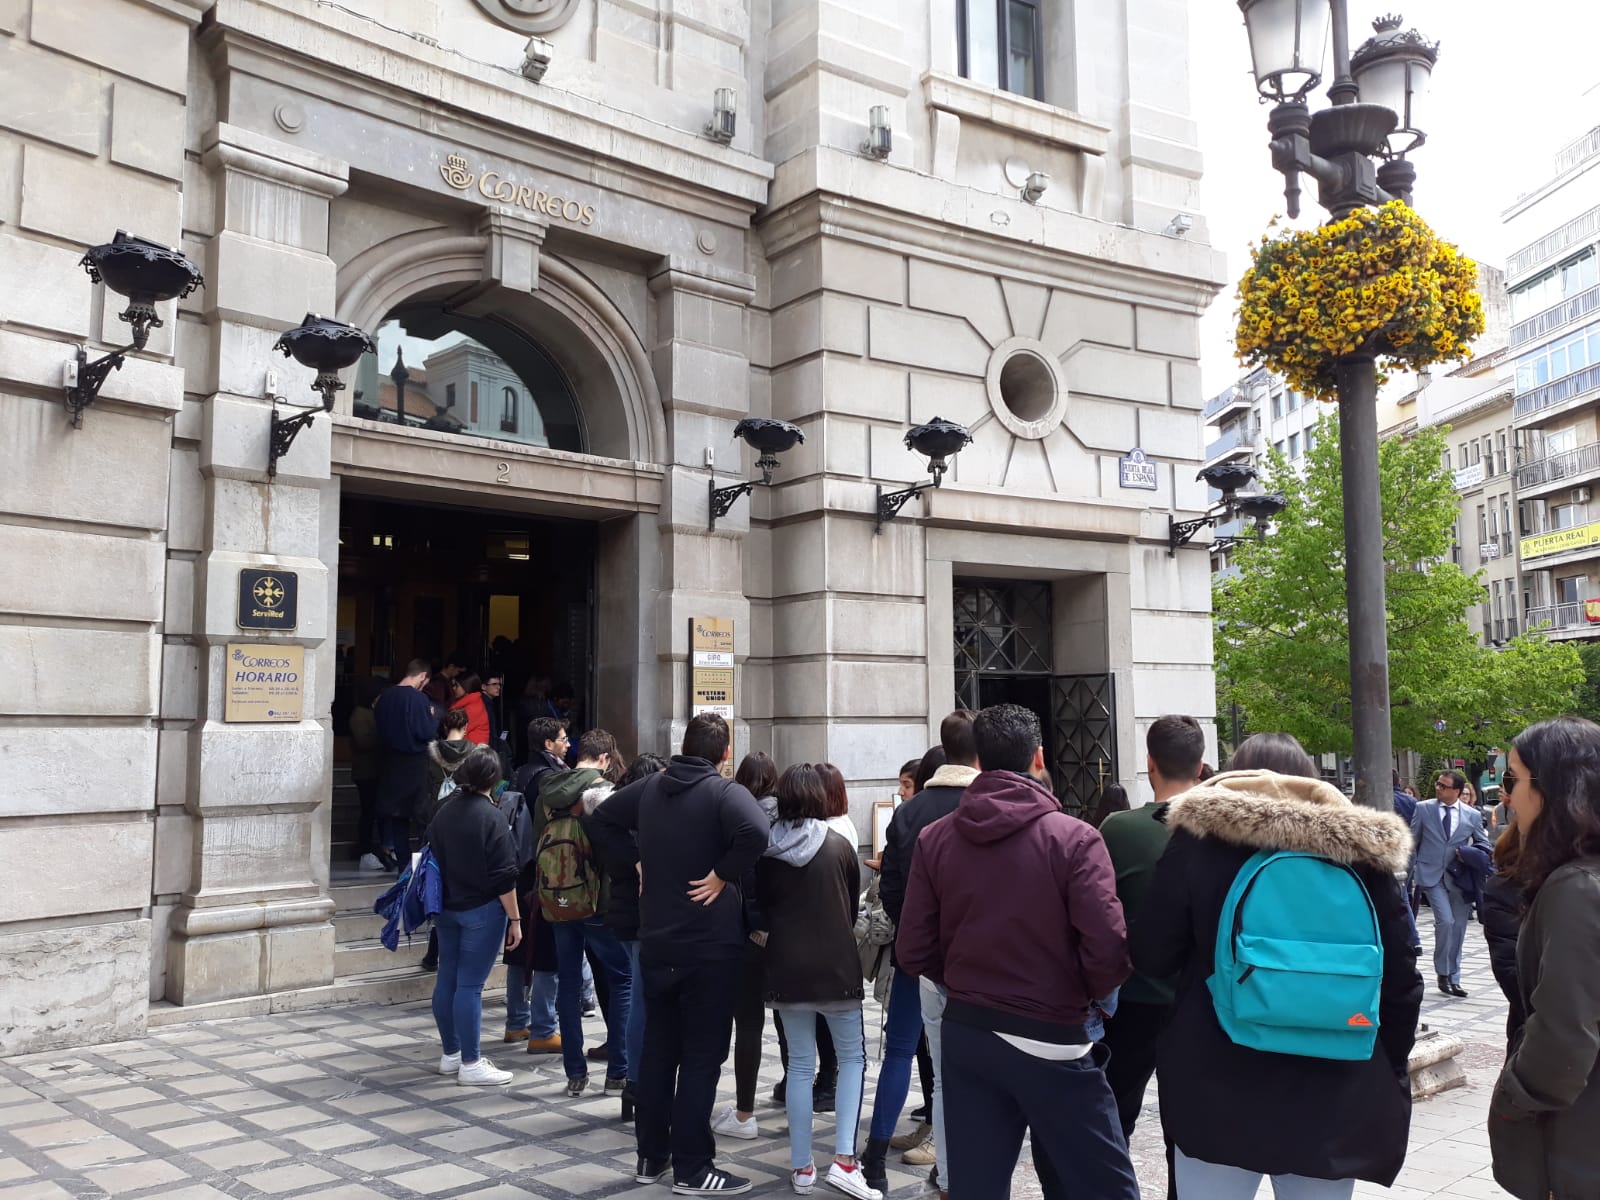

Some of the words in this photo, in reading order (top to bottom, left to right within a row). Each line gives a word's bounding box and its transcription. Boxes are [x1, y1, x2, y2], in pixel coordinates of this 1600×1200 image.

[478, 171, 595, 226] CORREOS
[497, 461, 510, 483] 2
[1533, 535, 1563, 548] PUERTA
[1565, 530, 1584, 540] REAL
[252, 609, 284, 618] ServiRed
[702, 630, 731, 638] CORREOS
[242, 656, 291, 668] CORREOS
[235, 671, 298, 683] HORARIO
